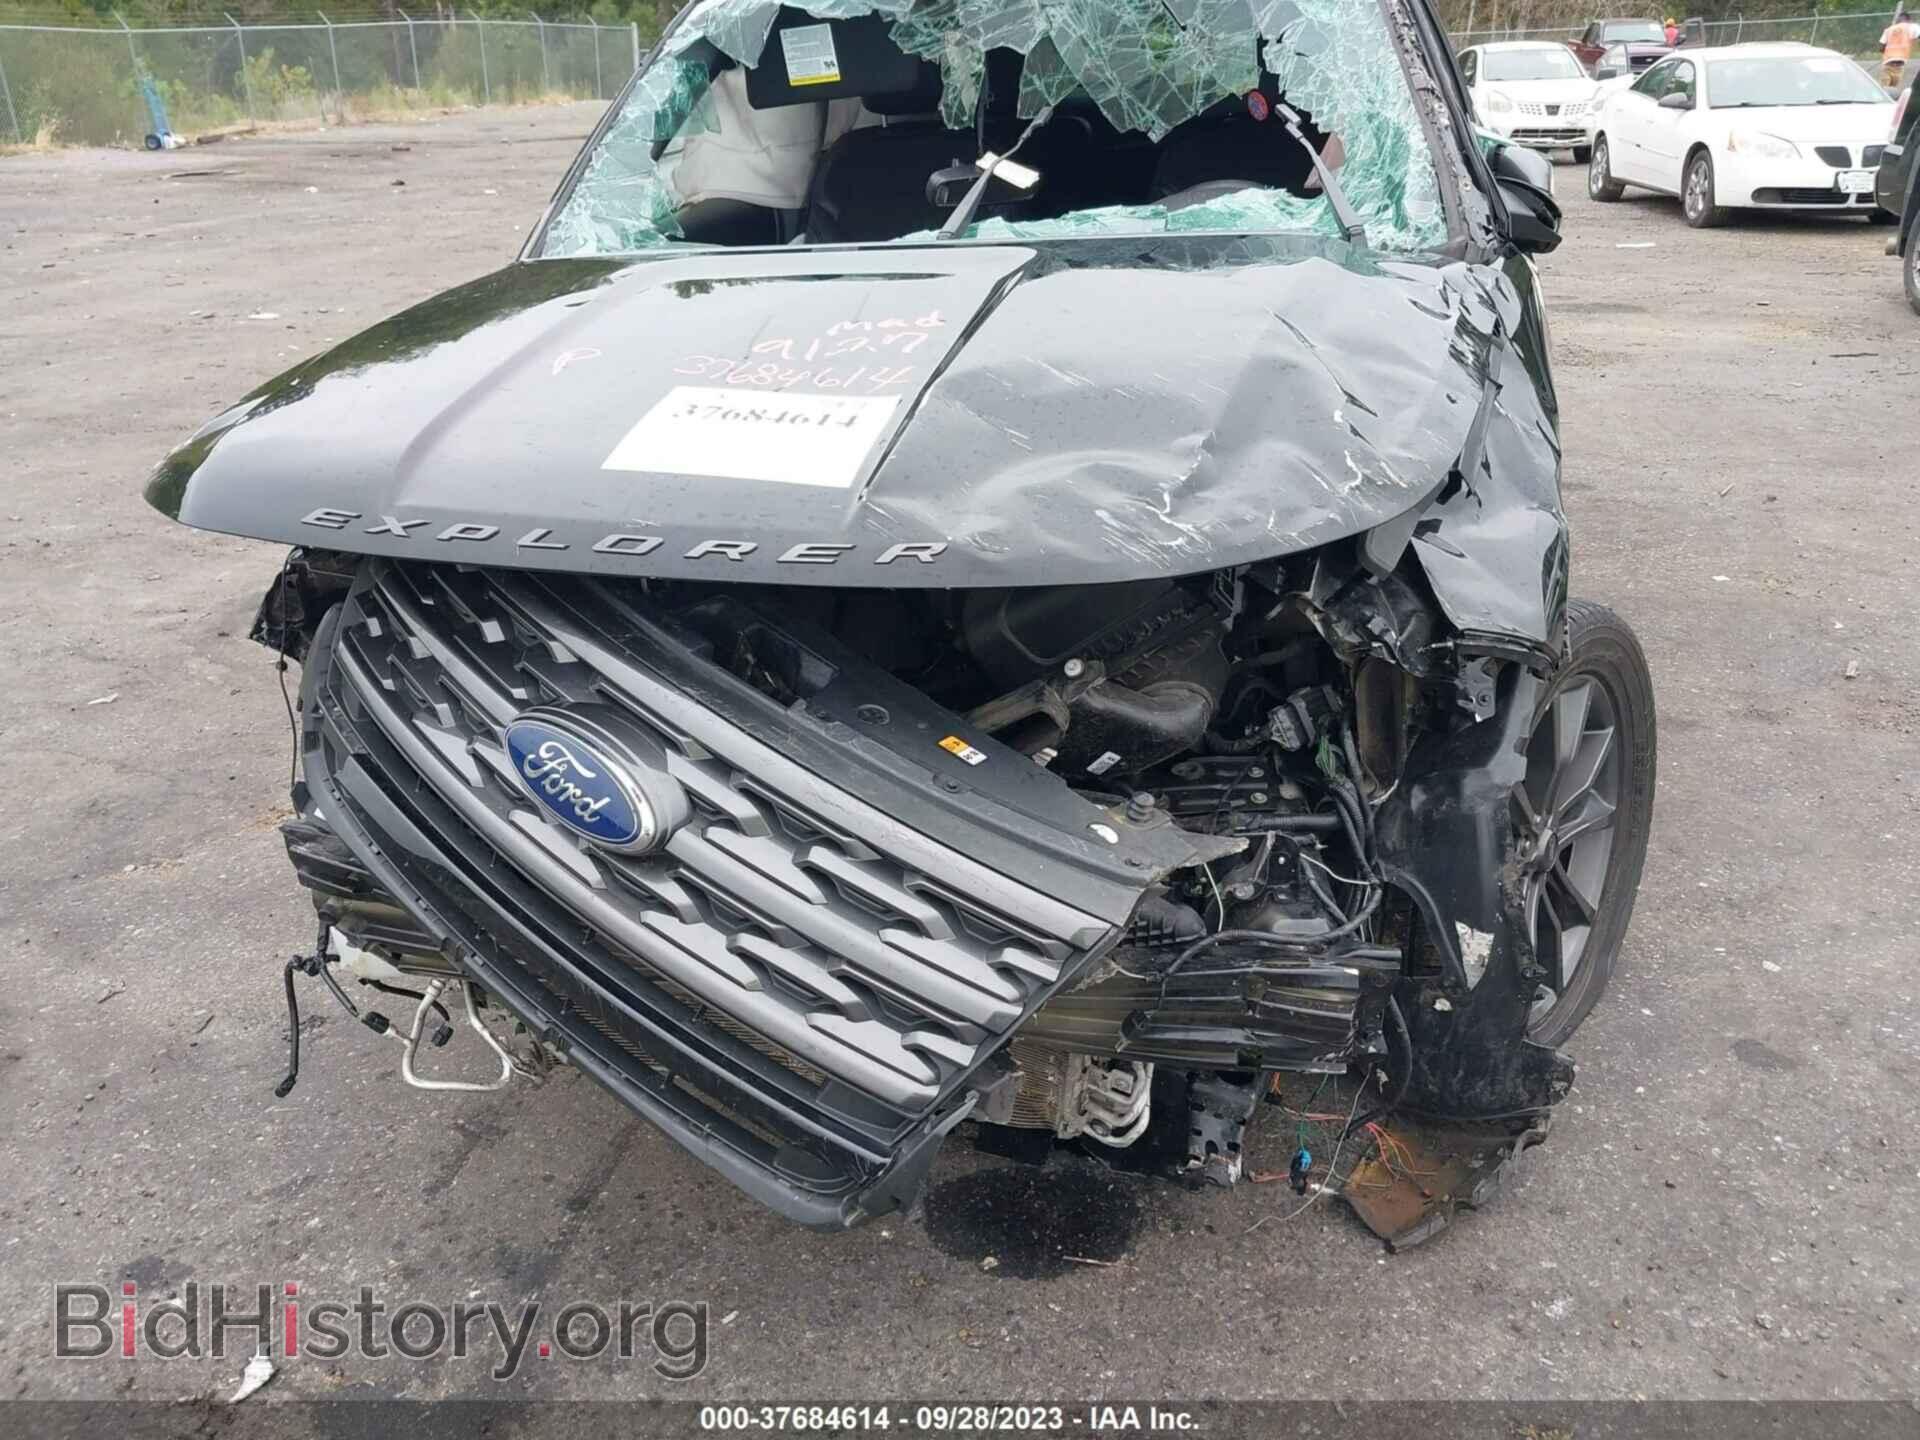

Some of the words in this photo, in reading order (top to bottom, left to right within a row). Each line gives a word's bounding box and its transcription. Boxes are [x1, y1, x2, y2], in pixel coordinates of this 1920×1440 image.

[672, 355, 914, 393] 37684614
[300, 506, 949, 566] EXPLORER
[523, 740, 612, 823] Ford
